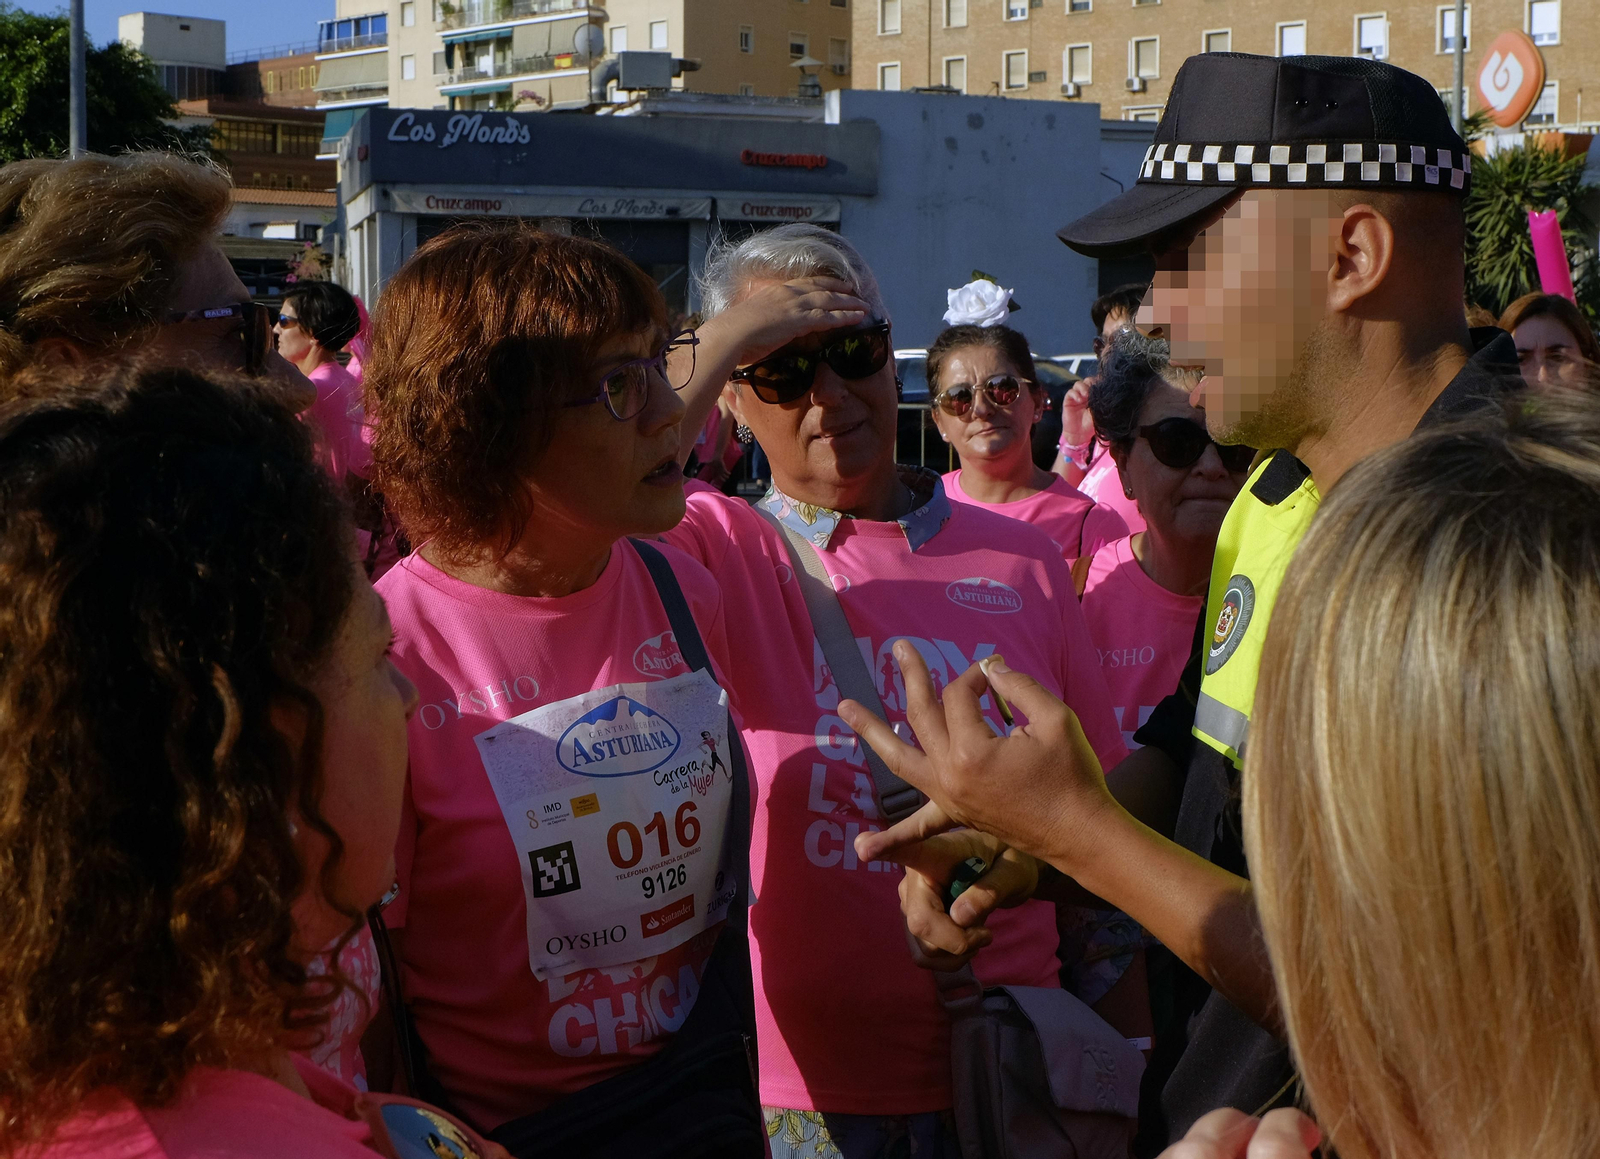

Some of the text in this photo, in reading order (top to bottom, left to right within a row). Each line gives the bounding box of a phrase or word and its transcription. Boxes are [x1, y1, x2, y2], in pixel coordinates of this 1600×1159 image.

[387, 112, 436, 142] Los
[740, 149, 828, 170] Cruzcampo
[426, 195, 502, 213] Cruzcampo
[578, 198, 607, 214] Los
[741, 202, 813, 219] Cruzcampo
[205, 308, 232, 317] RALPH
[953, 586, 1019, 608] ASTURIANA
[643, 652, 683, 671] ASTUR
[1096, 645, 1155, 668] YSHO
[419, 675, 540, 730] OYSHO
[573, 730, 675, 768] ASTURIANA
[653, 760, 700, 787] Carrera
[671, 769, 715, 797] de la Mujer
[807, 763, 879, 820] LA
[543, 802, 562, 814] IMD
[606, 801, 701, 870] 016
[615, 867, 649, 881] TELÉFONO
[649, 857, 677, 871] VIOLENCIA
[683, 846, 702, 859] GÉNERO
[641, 863, 687, 899] 9126
[660, 903, 692, 926] Santander
[546, 924, 627, 955] OYSHO
[548, 957, 710, 1058] CHICA
